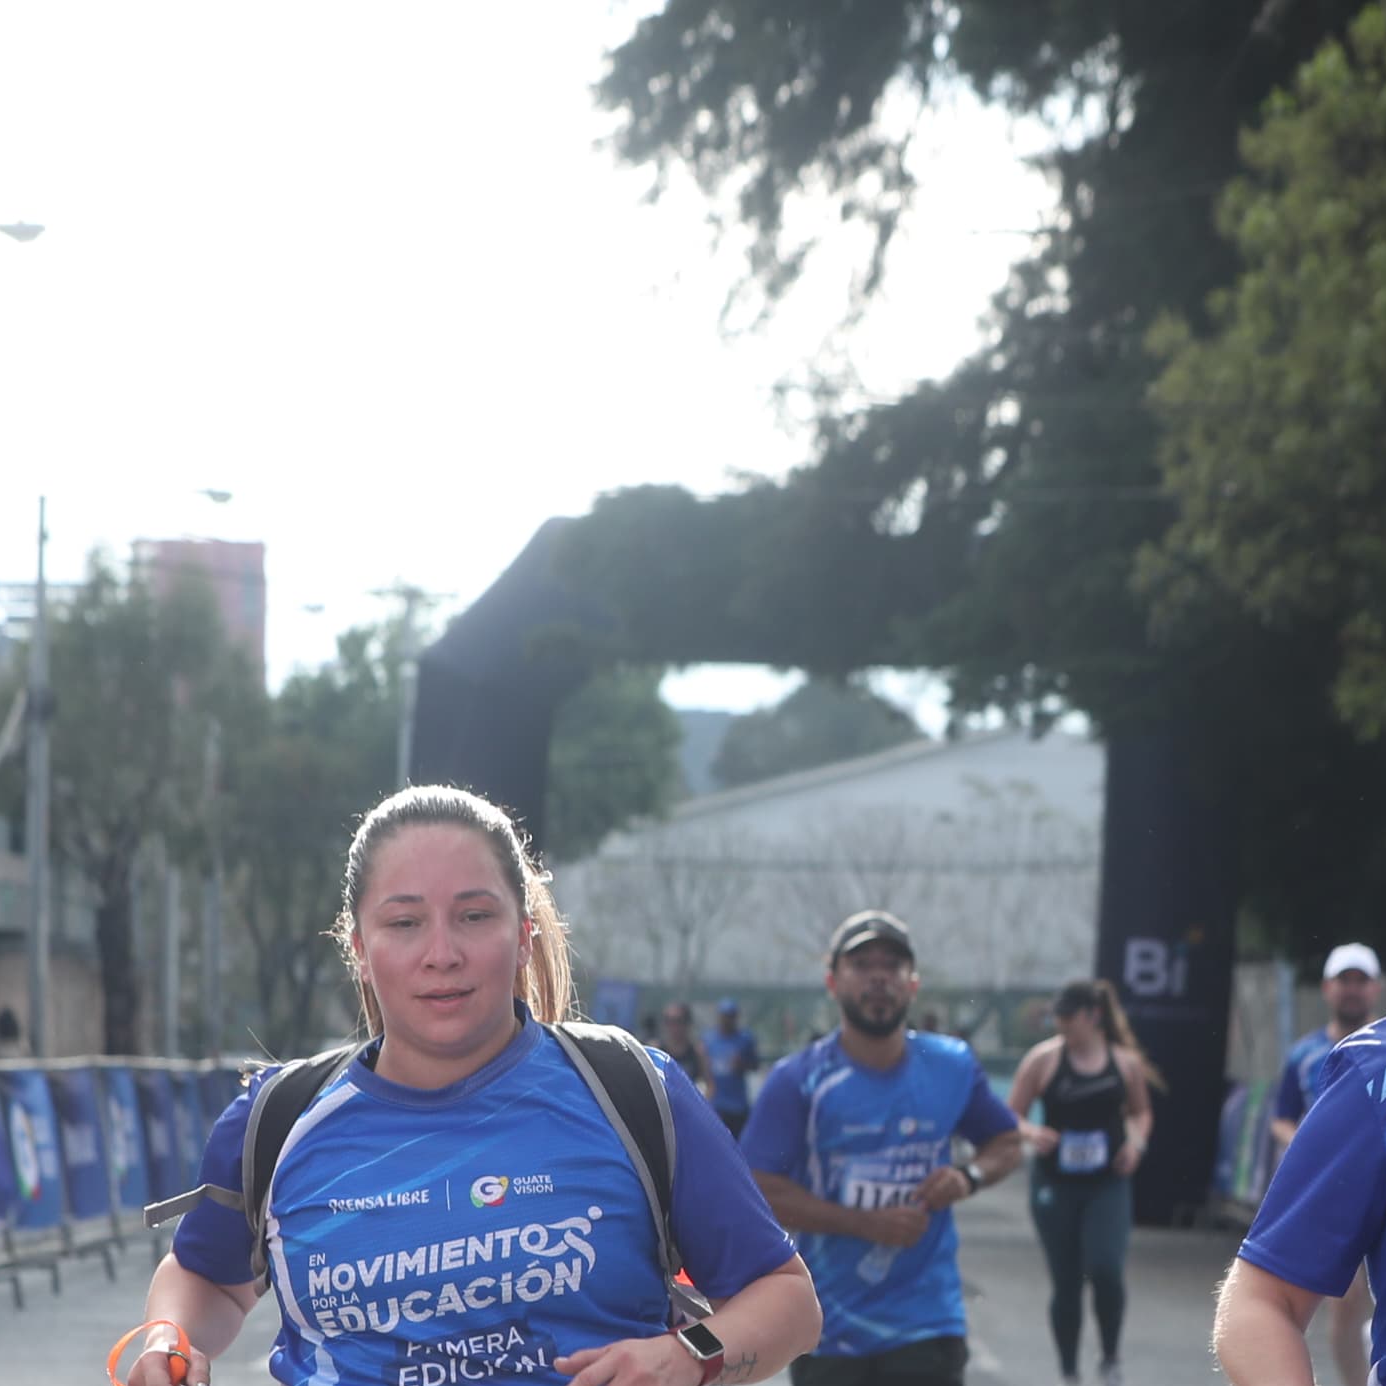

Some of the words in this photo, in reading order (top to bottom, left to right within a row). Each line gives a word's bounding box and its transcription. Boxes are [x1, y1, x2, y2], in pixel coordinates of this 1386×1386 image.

[308, 1223, 550, 1298] MOVIMIENTO
[309, 1253, 326, 1267] EN
[312, 1297, 338, 1310] POR
[342, 1292, 360, 1304] LA
[315, 1257, 582, 1338] EDUCACIÓN
[407, 1326, 525, 1358] PMERA
